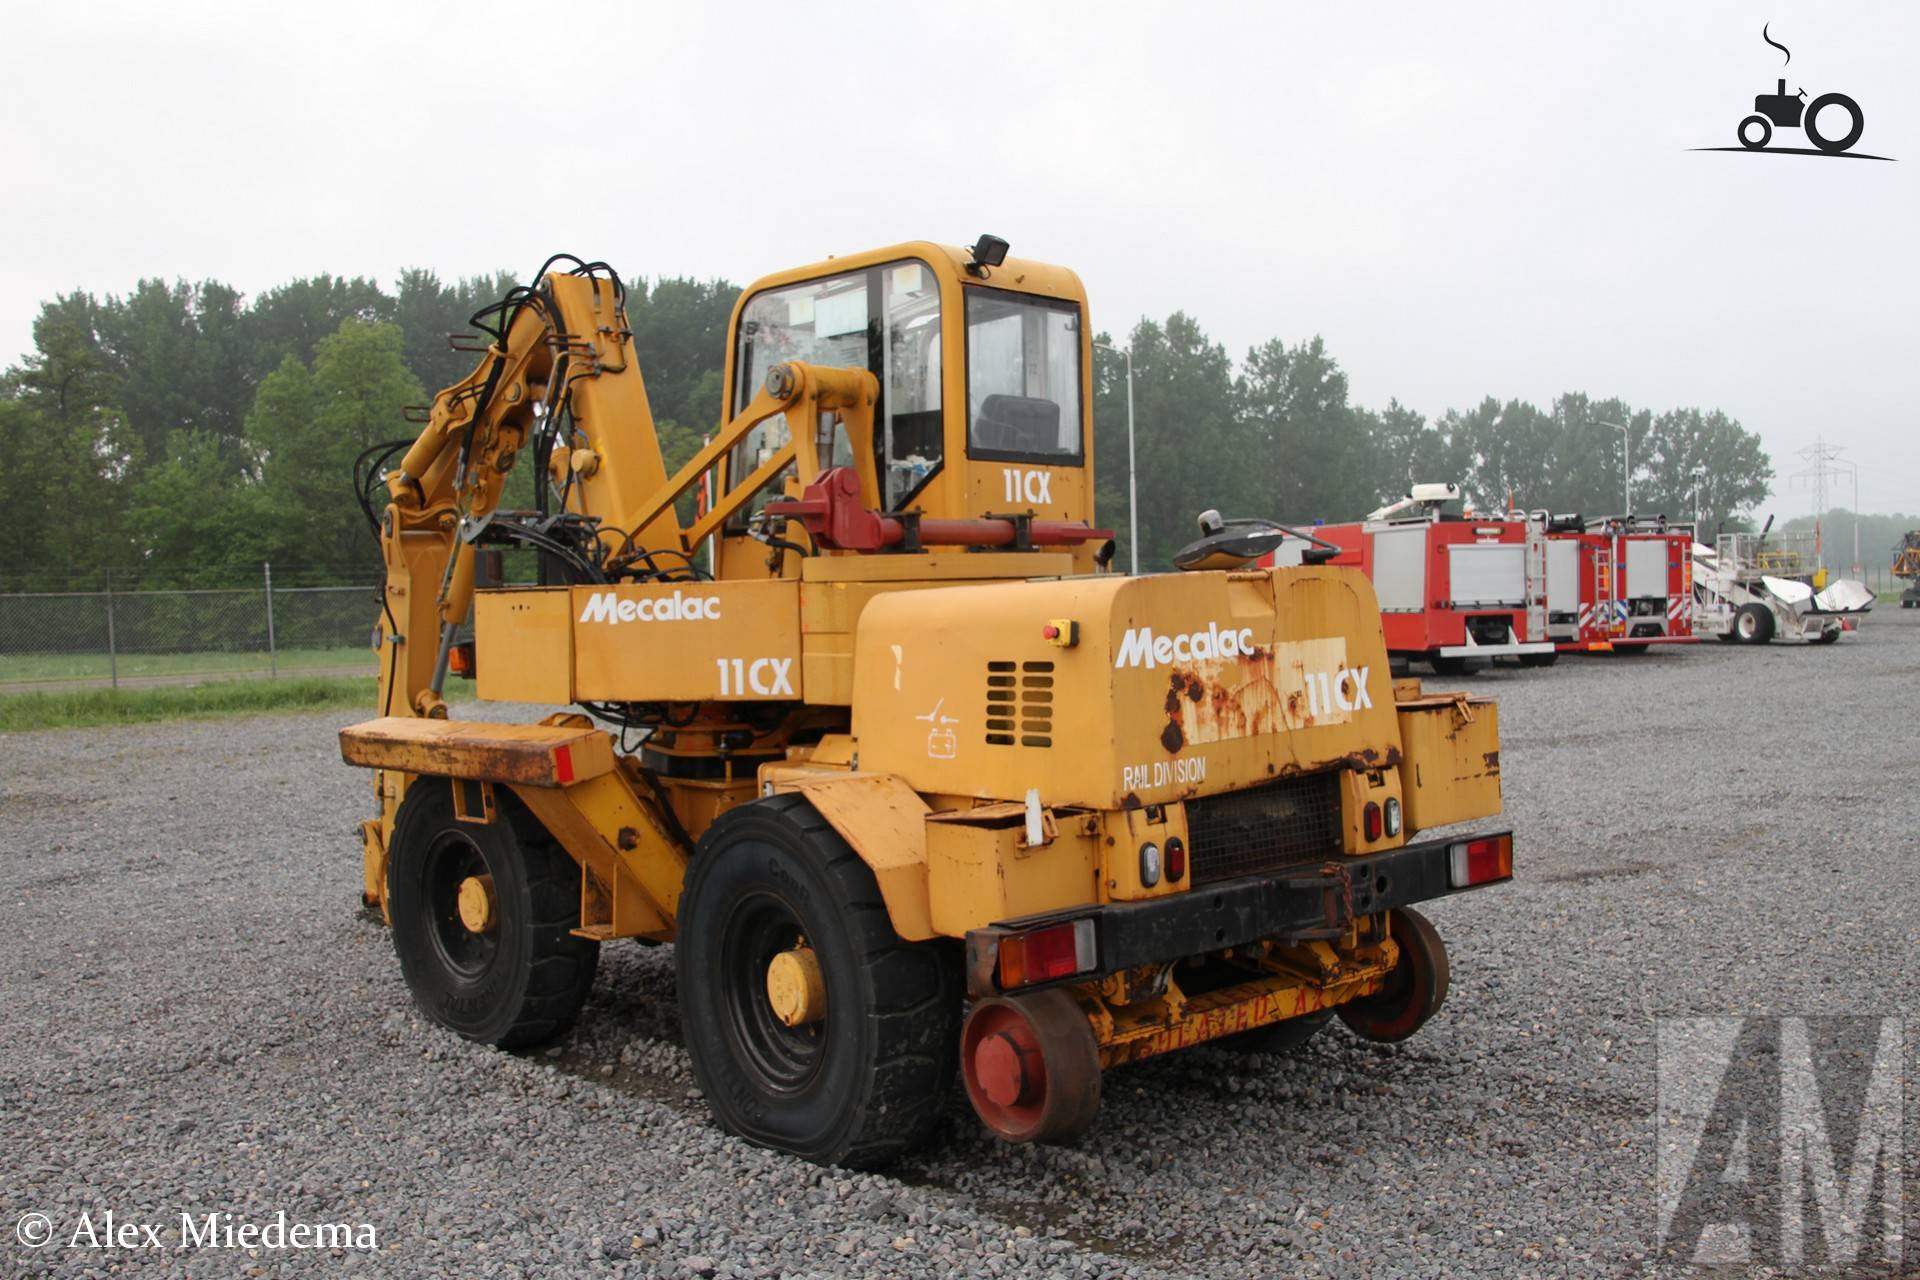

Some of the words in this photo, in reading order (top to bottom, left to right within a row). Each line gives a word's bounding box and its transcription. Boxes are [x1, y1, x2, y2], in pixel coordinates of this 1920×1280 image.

[1003, 468, 1052, 504] 11CX
[579, 590, 721, 625] Mecalac
[1115, 621, 1255, 669] Mecalac
[716, 657, 794, 695] 11CX
[1305, 666, 1373, 716] 11CX
[1123, 764, 1152, 791] RAIL
[1153, 756, 1206, 788] DIVISION
